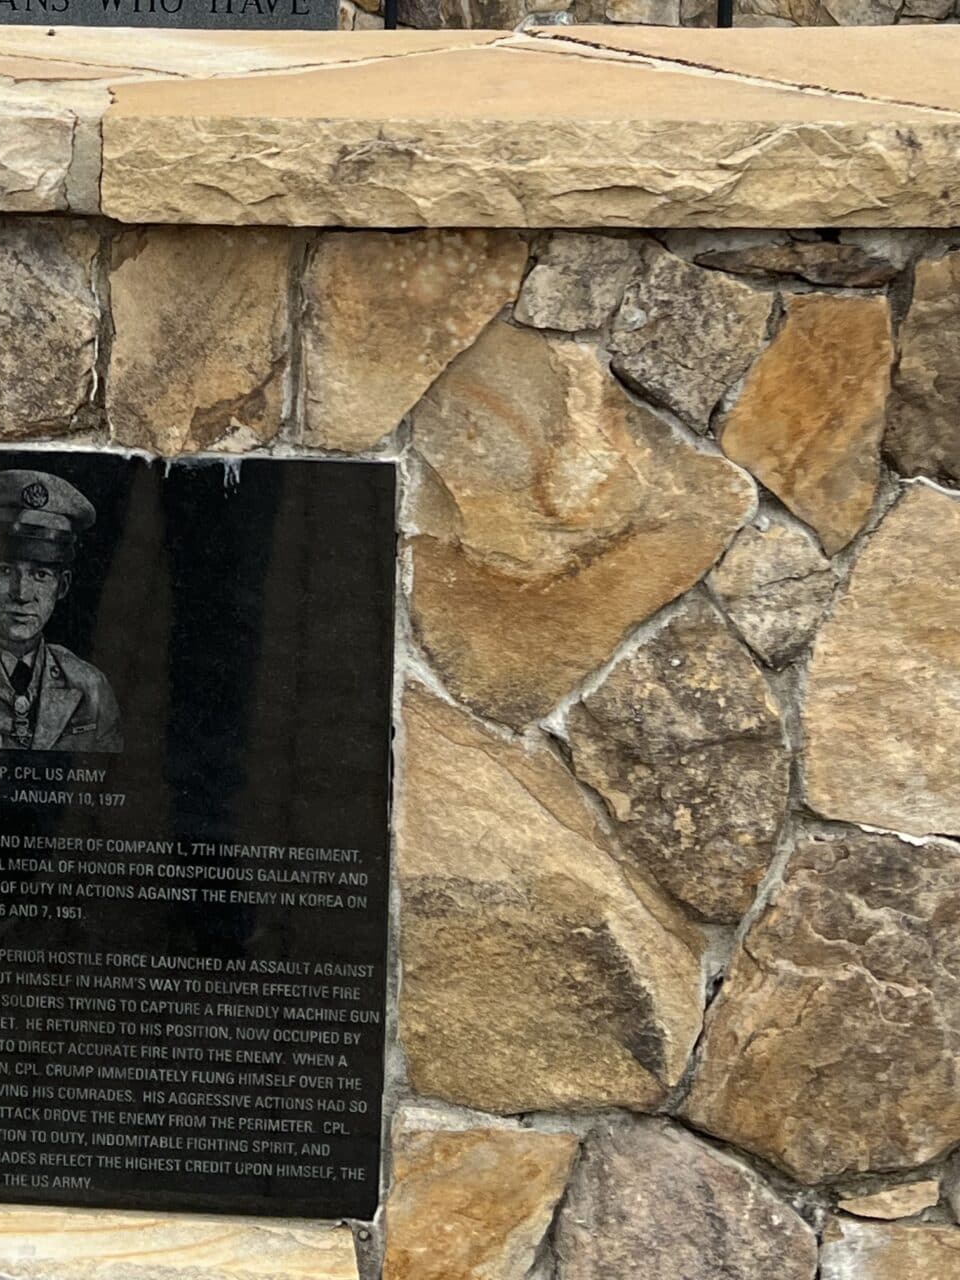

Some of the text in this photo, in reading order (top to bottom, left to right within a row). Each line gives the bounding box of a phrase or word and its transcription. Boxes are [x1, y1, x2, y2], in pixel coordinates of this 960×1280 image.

[45, 767, 63, 781] US
[66, 767, 106, 782] ARMY
[10, 788, 73, 804] JANUARY
[99, 791, 125, 806] 1977
[23, 835, 83, 851] MEMBER
[106, 838, 173, 854] COMPANY
[191, 841, 215, 856] 7TH
[219, 843, 285, 859] INFANTRY
[8, 857, 53, 872] MEDAL
[77, 860, 125, 875] HONOR
[128, 862, 154, 876] FOR
[157, 863, 253, 881] CONSPICUOUS
[257, 867, 335, 884] GALLANTRY
[19, 880, 54, 895] DUTY
[75, 882, 134, 898] ACTIONS
[137, 885, 197, 901] AGAINST
[229, 889, 276, 904] ENEMY
[298, 892, 343, 907] KOREA
[8, 902, 37, 917] AND
[48, 949, 102, 965] HOSTILE
[105, 952, 146, 967] FORCE
[150, 954, 222, 971] LAUNCHED
[249, 958, 310, 975] ASSAULT
[313, 961, 375, 978] AGAINST
[15, 971, 71, 987] HIMSELF
[93, 974, 145, 990] HARM'S
[149, 976, 180, 991] WAY
[204, 979, 258, 995] DELIVER
[262, 981, 328, 998] EFFECTIVE
[332, 985, 360, 1000] FIRE
[1, 993, 64, 1009] SOLDIERS
[68, 996, 116, 1011] TRYING
[140, 999, 200, 1015] CAPTURE
[216, 1002, 279, 1019] FRIENDLY
[282, 1005, 346, 1022] MACHINE
[349, 1009, 379, 1024] GUN
[46, 1017, 115, 1034] RETURNED
[272, 1027, 339, 1044] OCCUPIED
[18, 1038, 65, 1054] DIRECT
[67, 1041, 136, 1057] ACCURATE
[140, 1044, 168, 1059] FIRE
[292, 1051, 334, 1067] WHEN
[45, 1062, 94, 1078] CRUMP
[97, 1064, 188, 1082] IMMEDIATELY
[191, 1069, 234, 1085] FLUNG
[238, 1071, 295, 1087] HIMSELF
[298, 1074, 333, 1089] OVER
[168, 1090, 251, 1108] AGGRESSIVE
[254, 1094, 313, 1111] ACTIONS
[43, 1107, 86, 1122] DROVE
[118, 1110, 165, 1126] ENEMY
[168, 1112, 206, 1128] FROM
[91, 1131, 182, 1149] INDOMITABLE
[186, 1136, 248, 1152] FIGHTING
[39, 1151, 93, 1167] REFLECT
[124, 1155, 181, 1171] HIGHEST
[184, 1158, 231, 1174] CREDIT
[234, 1160, 272, 1176] UPON
[4, 1172, 27, 1186] THE
[30, 1173, 48, 1188] US
